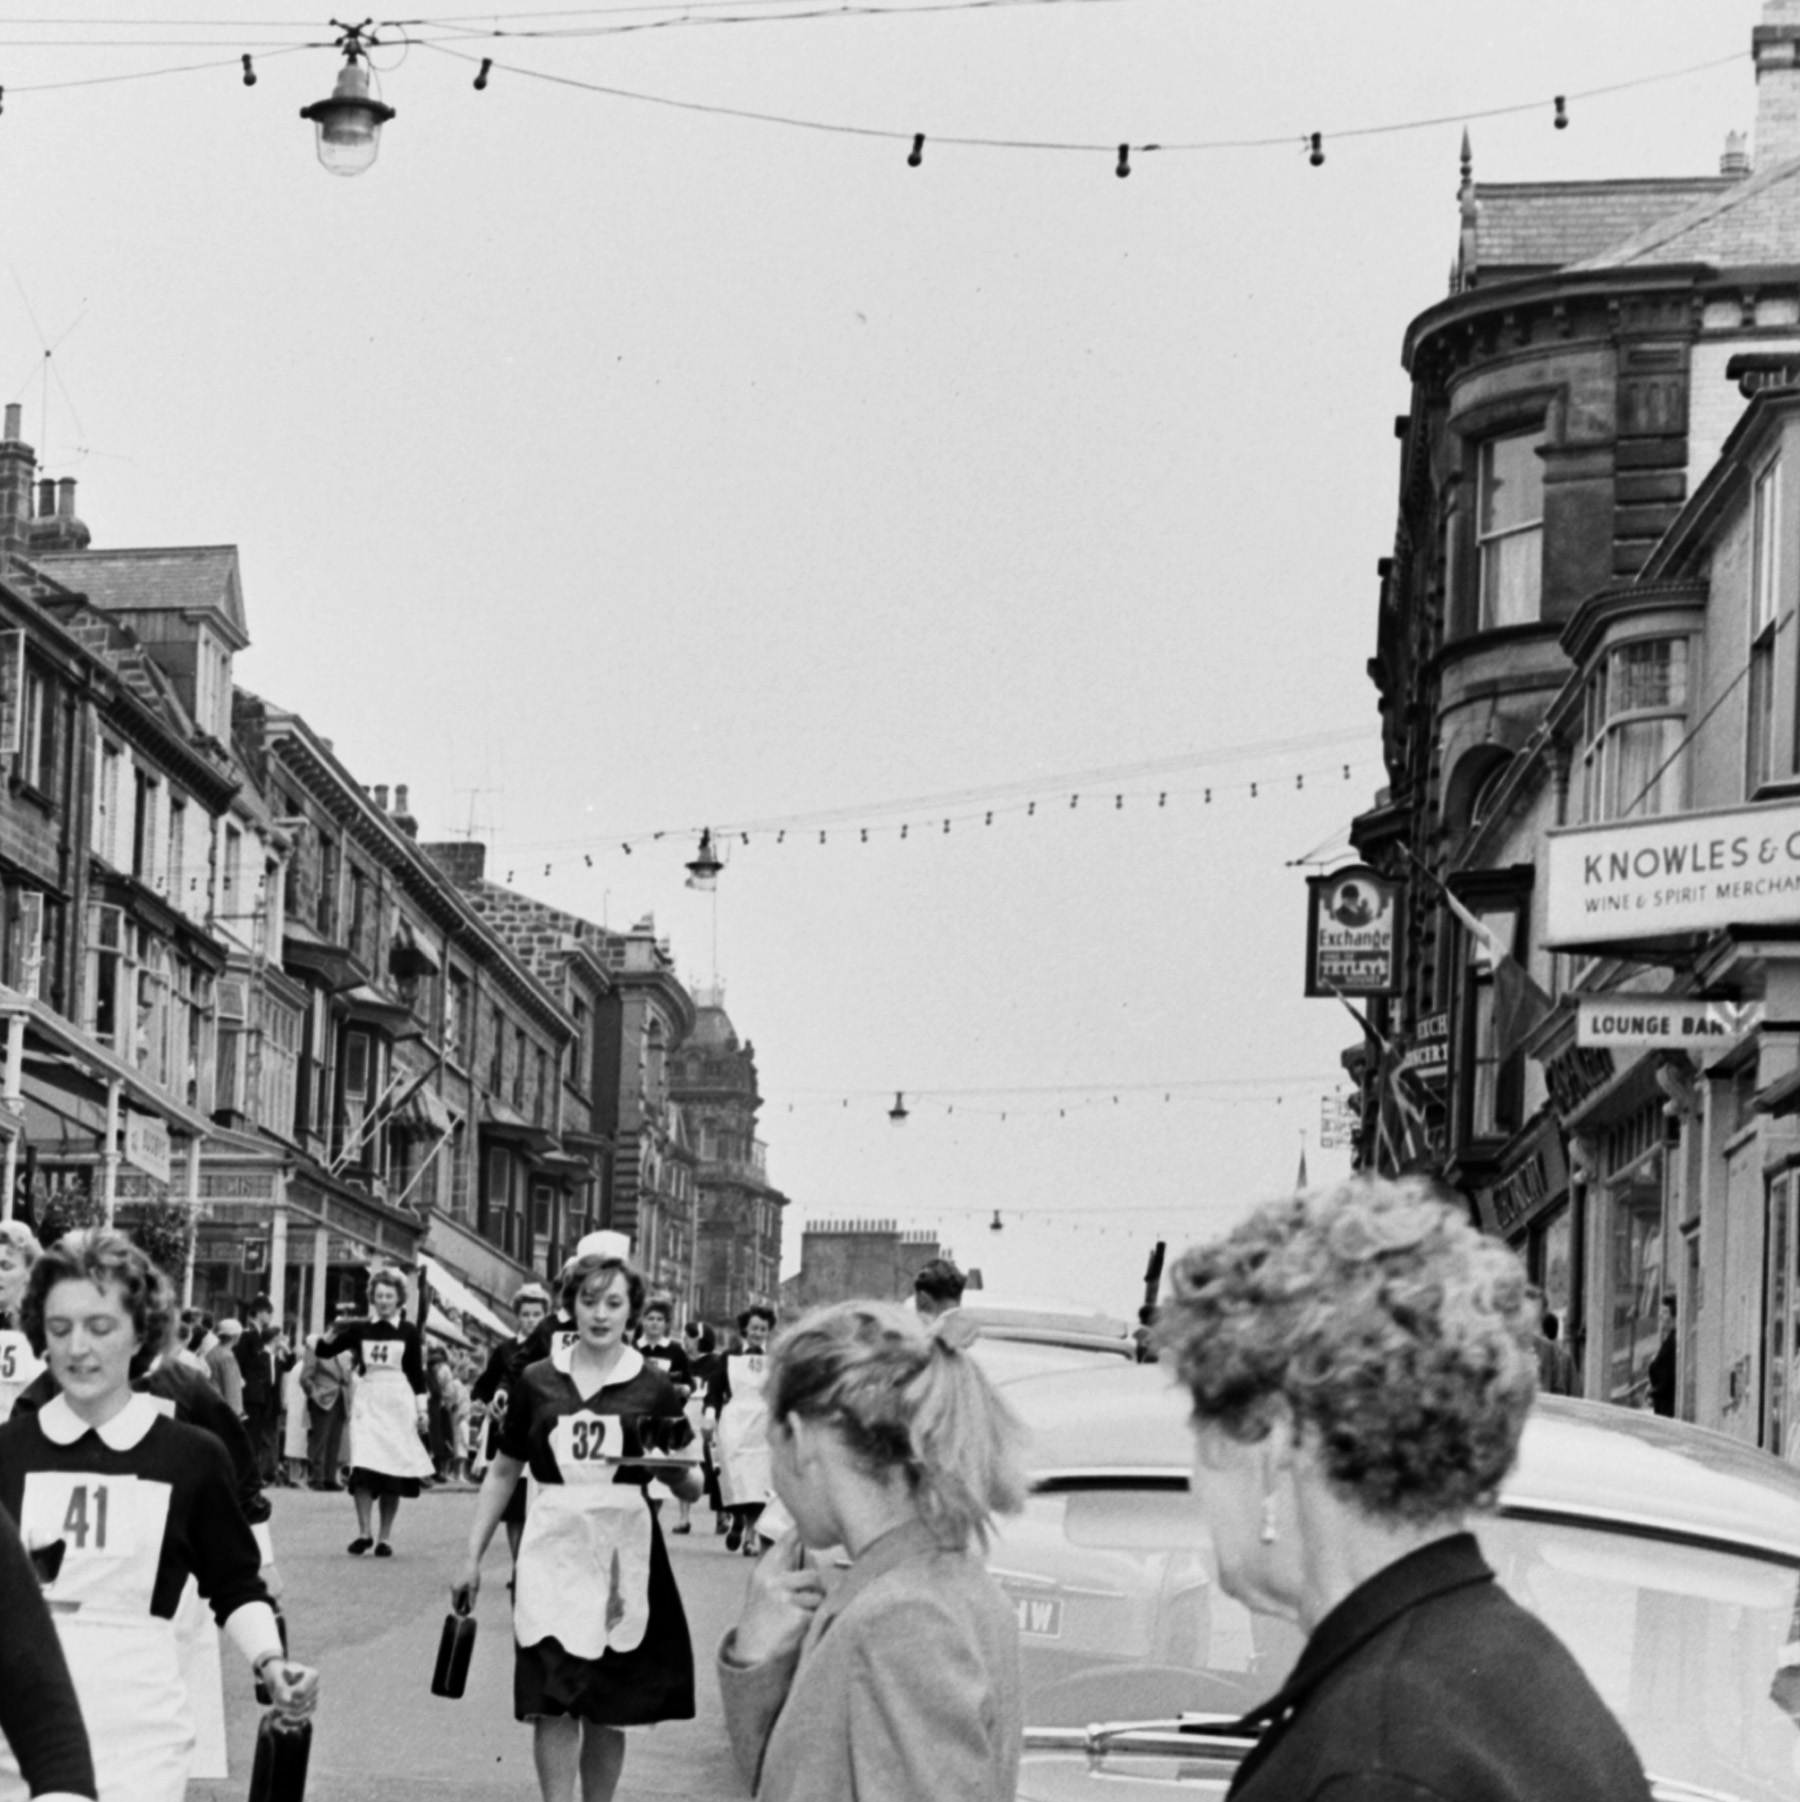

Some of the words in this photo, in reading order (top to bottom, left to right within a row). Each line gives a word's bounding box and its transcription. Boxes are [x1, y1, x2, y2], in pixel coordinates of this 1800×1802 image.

[1584, 836, 1749, 885] KNOWLES
[1758, 837, 1779, 864] &
[1584, 893, 1630, 913] WINE
[1653, 885, 1708, 908] SPIRIT
[1591, 1016, 1670, 1035] LOUNGE
[370, 1344, 388, 1363] 44
[572, 1420, 606, 1461] 32
[63, 1486, 108, 1551] 41
